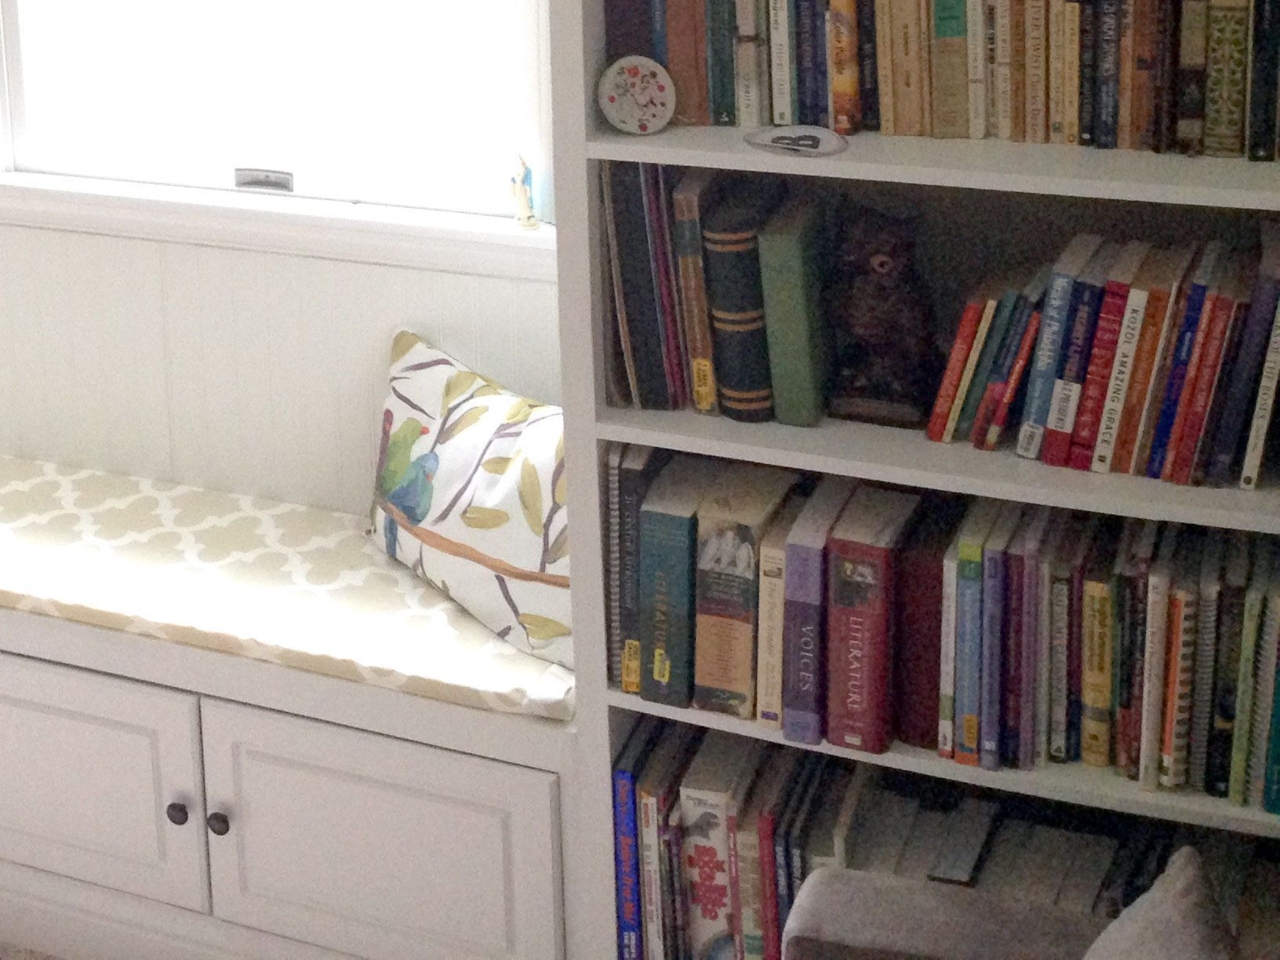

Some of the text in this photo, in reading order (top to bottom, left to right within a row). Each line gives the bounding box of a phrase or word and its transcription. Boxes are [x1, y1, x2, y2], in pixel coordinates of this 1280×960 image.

[1102, 13, 1117, 40] GREAT
[1030, 36, 1040, 69] TWIST
[1101, 42, 1117, 76] STORIES
[1048, 275, 1068, 308] Miracle
[1034, 318, 1060, 372] Philadelphia
[1099, 307, 1140, 446] KOZOL AMAZING GRACE
[1255, 384, 1271, 421] ROSES
[653, 571, 667, 649] LITERATUR
[1097, 596, 1107, 631] English
[799, 624, 814, 691] VOICES
[846, 615, 863, 710] LITERATURE
